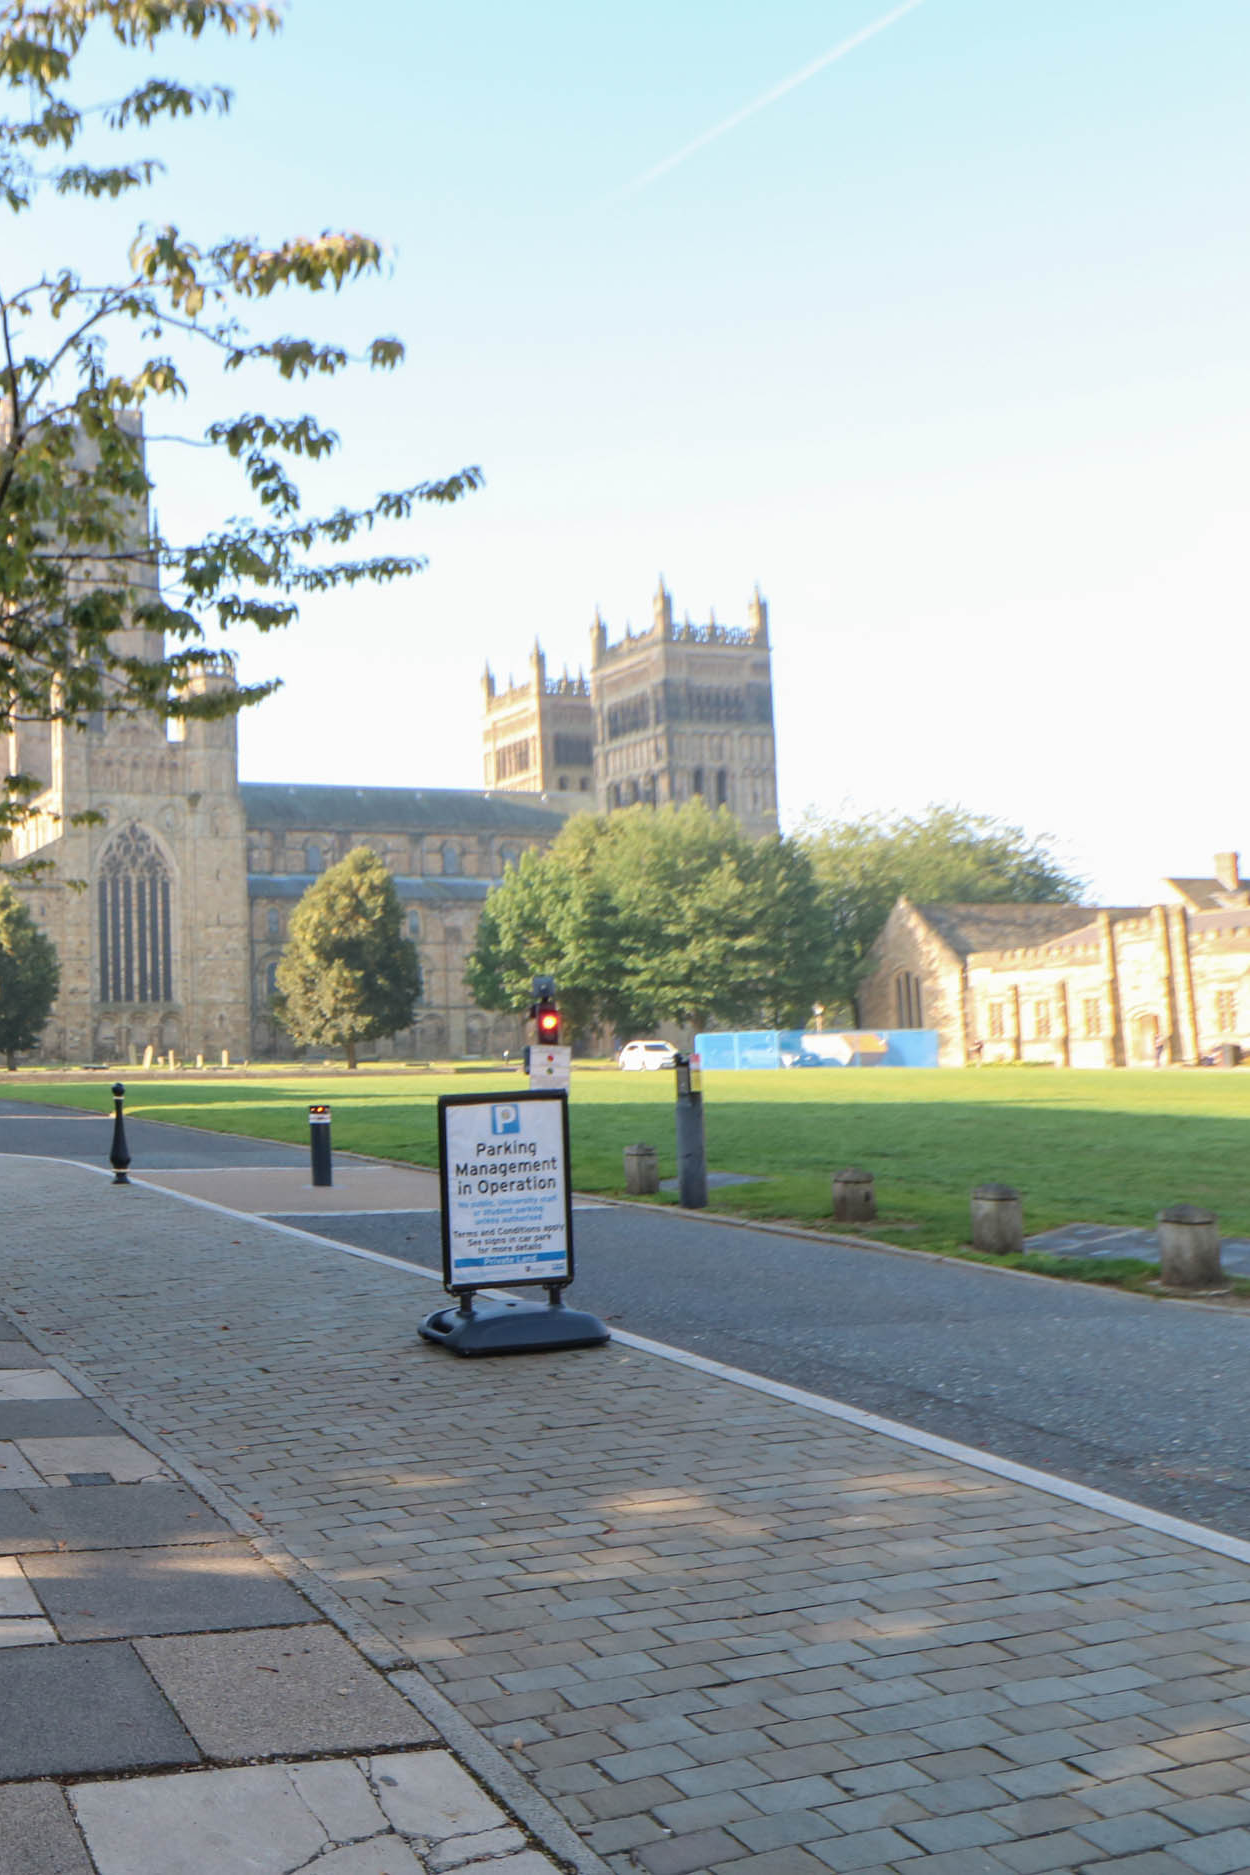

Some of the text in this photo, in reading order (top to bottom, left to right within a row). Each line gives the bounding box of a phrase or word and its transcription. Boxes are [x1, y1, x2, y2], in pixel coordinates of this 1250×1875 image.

[476, 1141, 537, 1157] Parking
[455, 1157, 558, 1177] Management
[458, 1176, 556, 1196] in Operation
[453, 1223, 565, 1238] Terms and Conditions apply
[468, 1239, 482, 1247] See
[484, 1237, 506, 1246] signs
[533, 1234, 552, 1242] park
[478, 1243, 542, 1254] for more details
